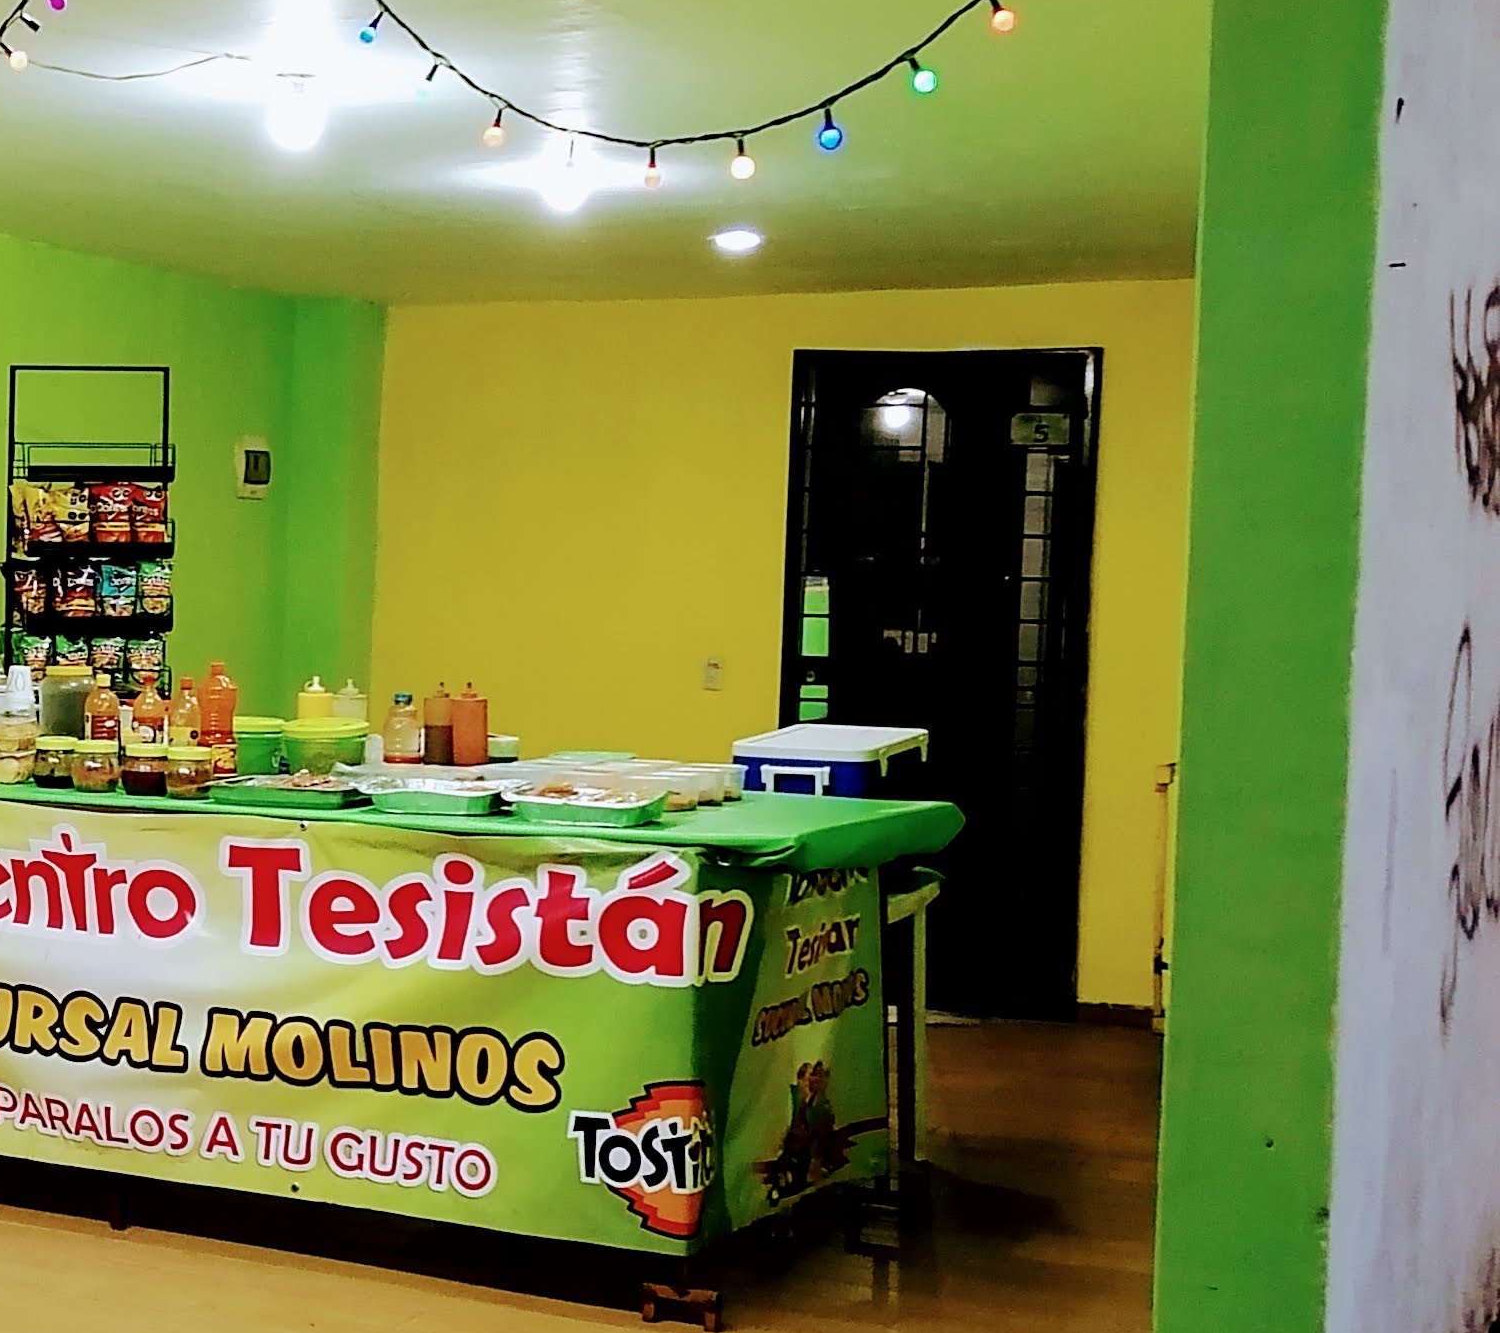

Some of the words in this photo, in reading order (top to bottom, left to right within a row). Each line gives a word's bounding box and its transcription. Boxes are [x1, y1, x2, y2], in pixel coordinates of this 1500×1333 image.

[228, 844, 747, 976] Tesistán
[203, 1007, 564, 1113] MOLINOS
[205, 1117, 240, 1157] A
[255, 1121, 313, 1165] TU
[330, 1131, 493, 1193] GUSTO
